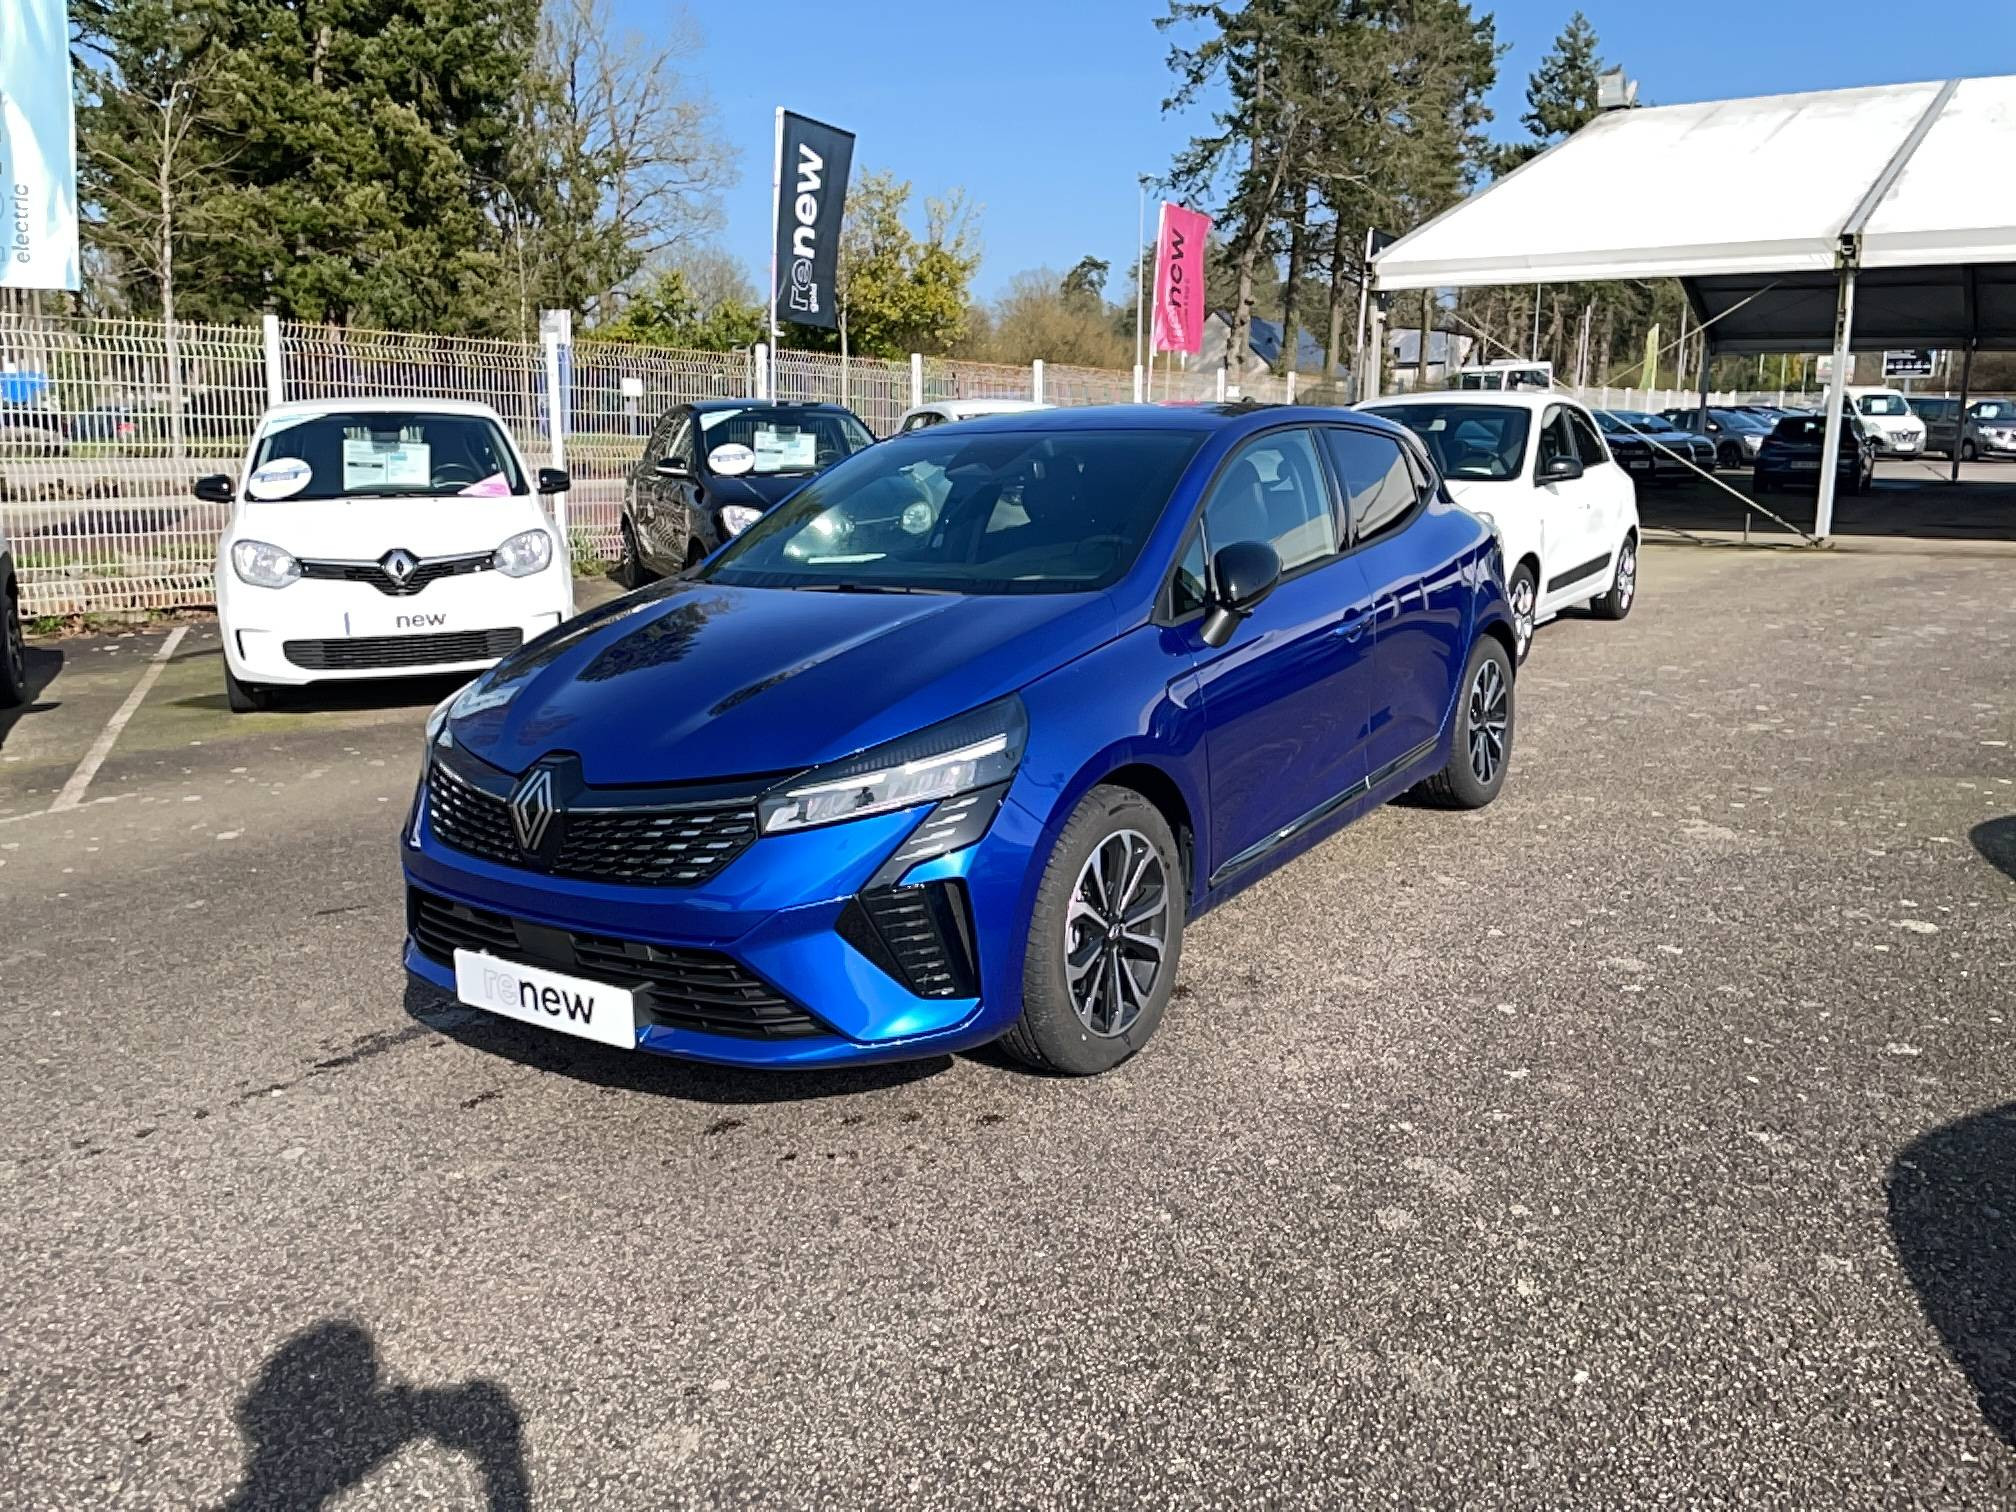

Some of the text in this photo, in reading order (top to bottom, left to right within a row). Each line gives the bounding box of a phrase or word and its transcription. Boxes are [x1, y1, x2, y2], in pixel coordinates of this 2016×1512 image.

[11, 183, 31, 264] electric
[789, 142, 824, 311] renew
[483, 966, 595, 1024] renew
